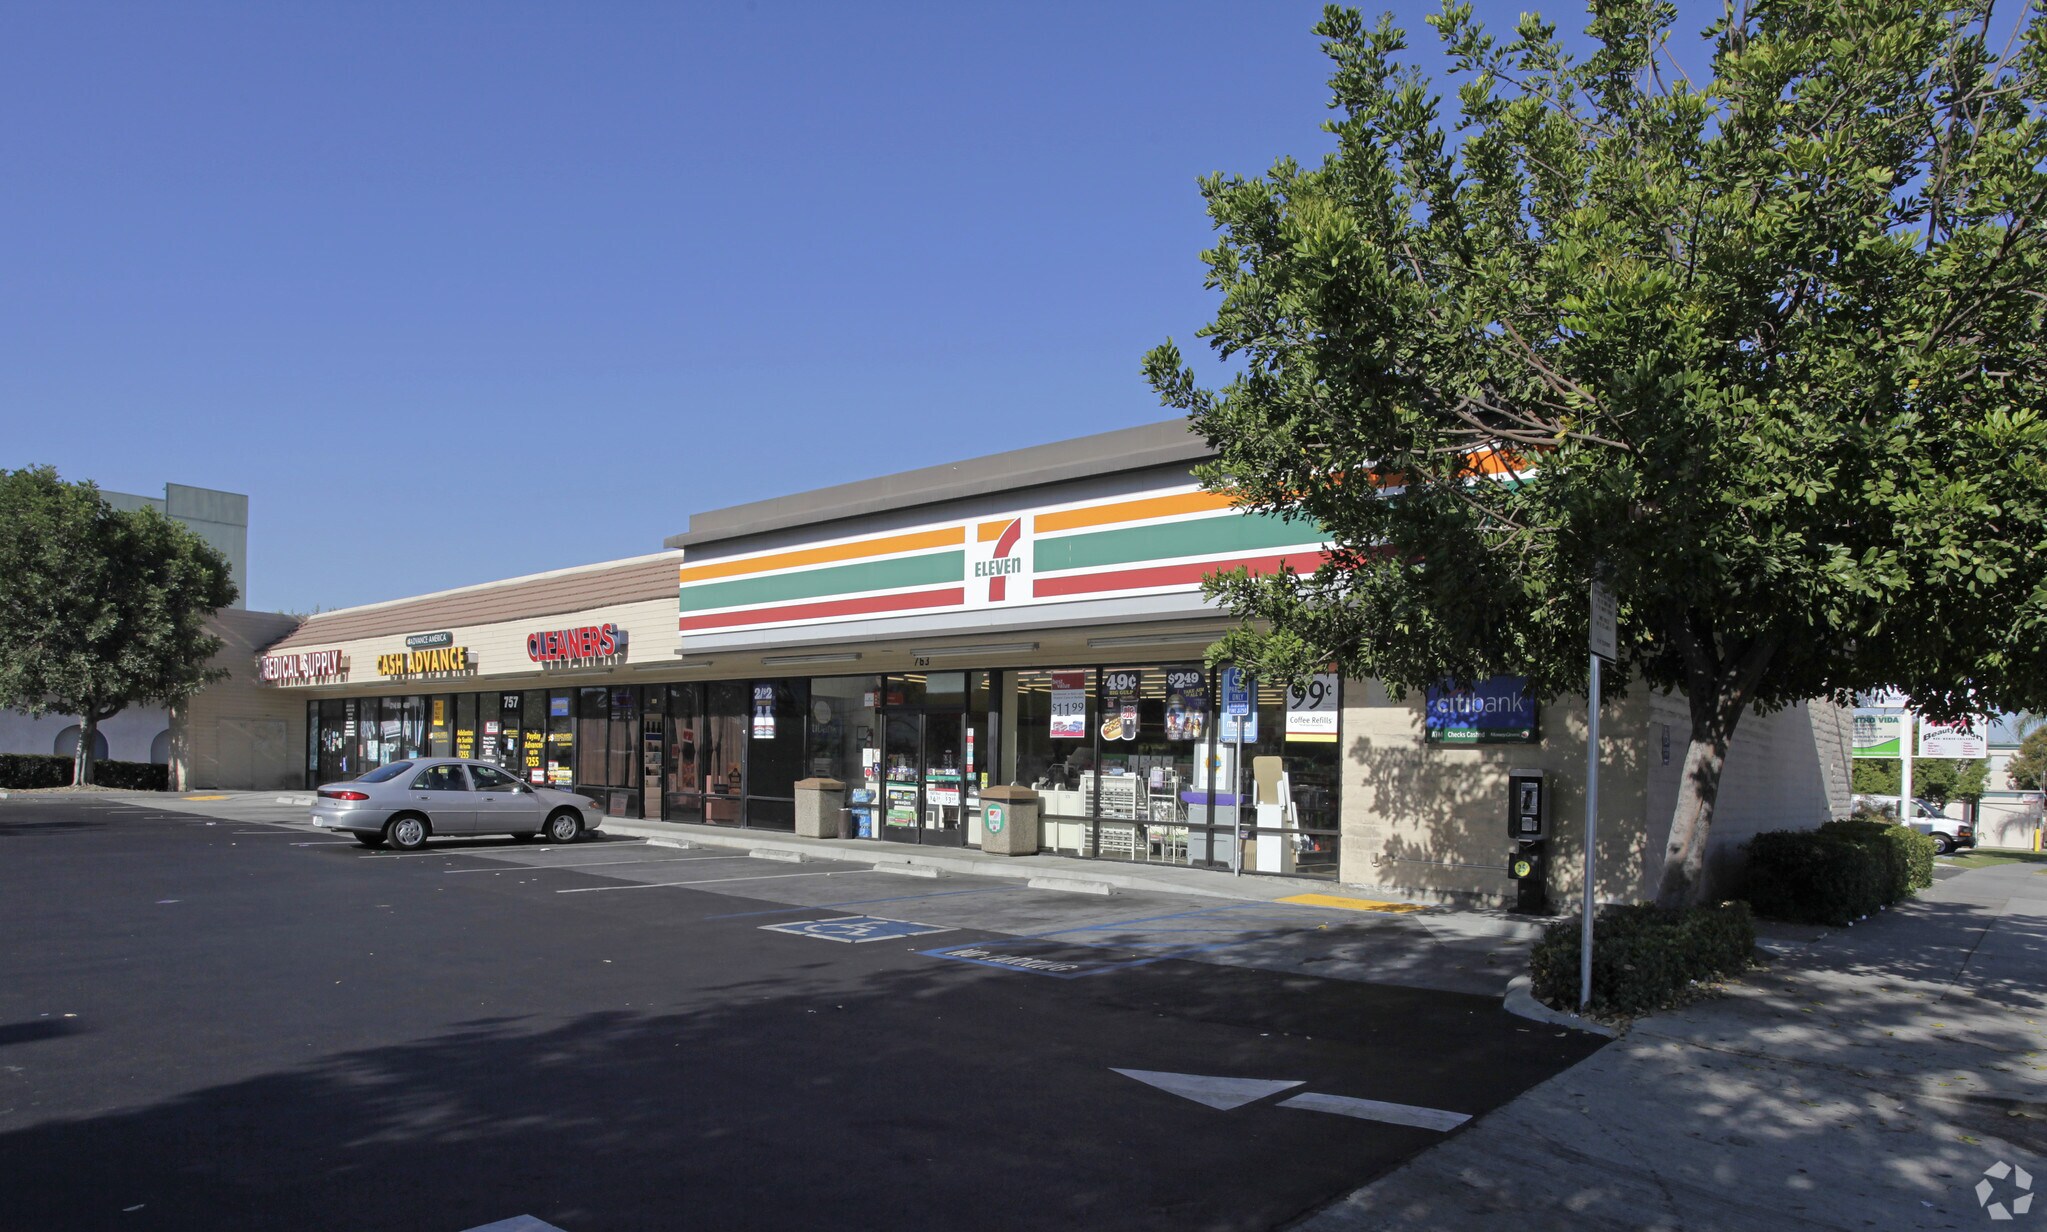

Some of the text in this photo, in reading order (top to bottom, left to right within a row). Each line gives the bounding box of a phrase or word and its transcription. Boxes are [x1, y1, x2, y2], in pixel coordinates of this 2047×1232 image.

[989, 517, 1021, 602] 7
[409, 633, 447, 645] ADVANCE AMERICA
[527, 623, 615, 662] CLEANERS
[263, 651, 339, 681] MEDICAL SUPPLY
[376, 647, 465, 676] CASH ADVANCE
[1106, 674, 1137, 691] 49¢
[504, 696, 518, 709] 757
[1437, 692, 1524, 714] citibank
[1289, 716, 1332, 724] Coffee Refills
[526, 732, 542, 741] Payday
[1923, 728, 1955, 741] Beauty
[526, 757, 540, 767] $255
[945, 947, 1079, 972] NO PARKING
